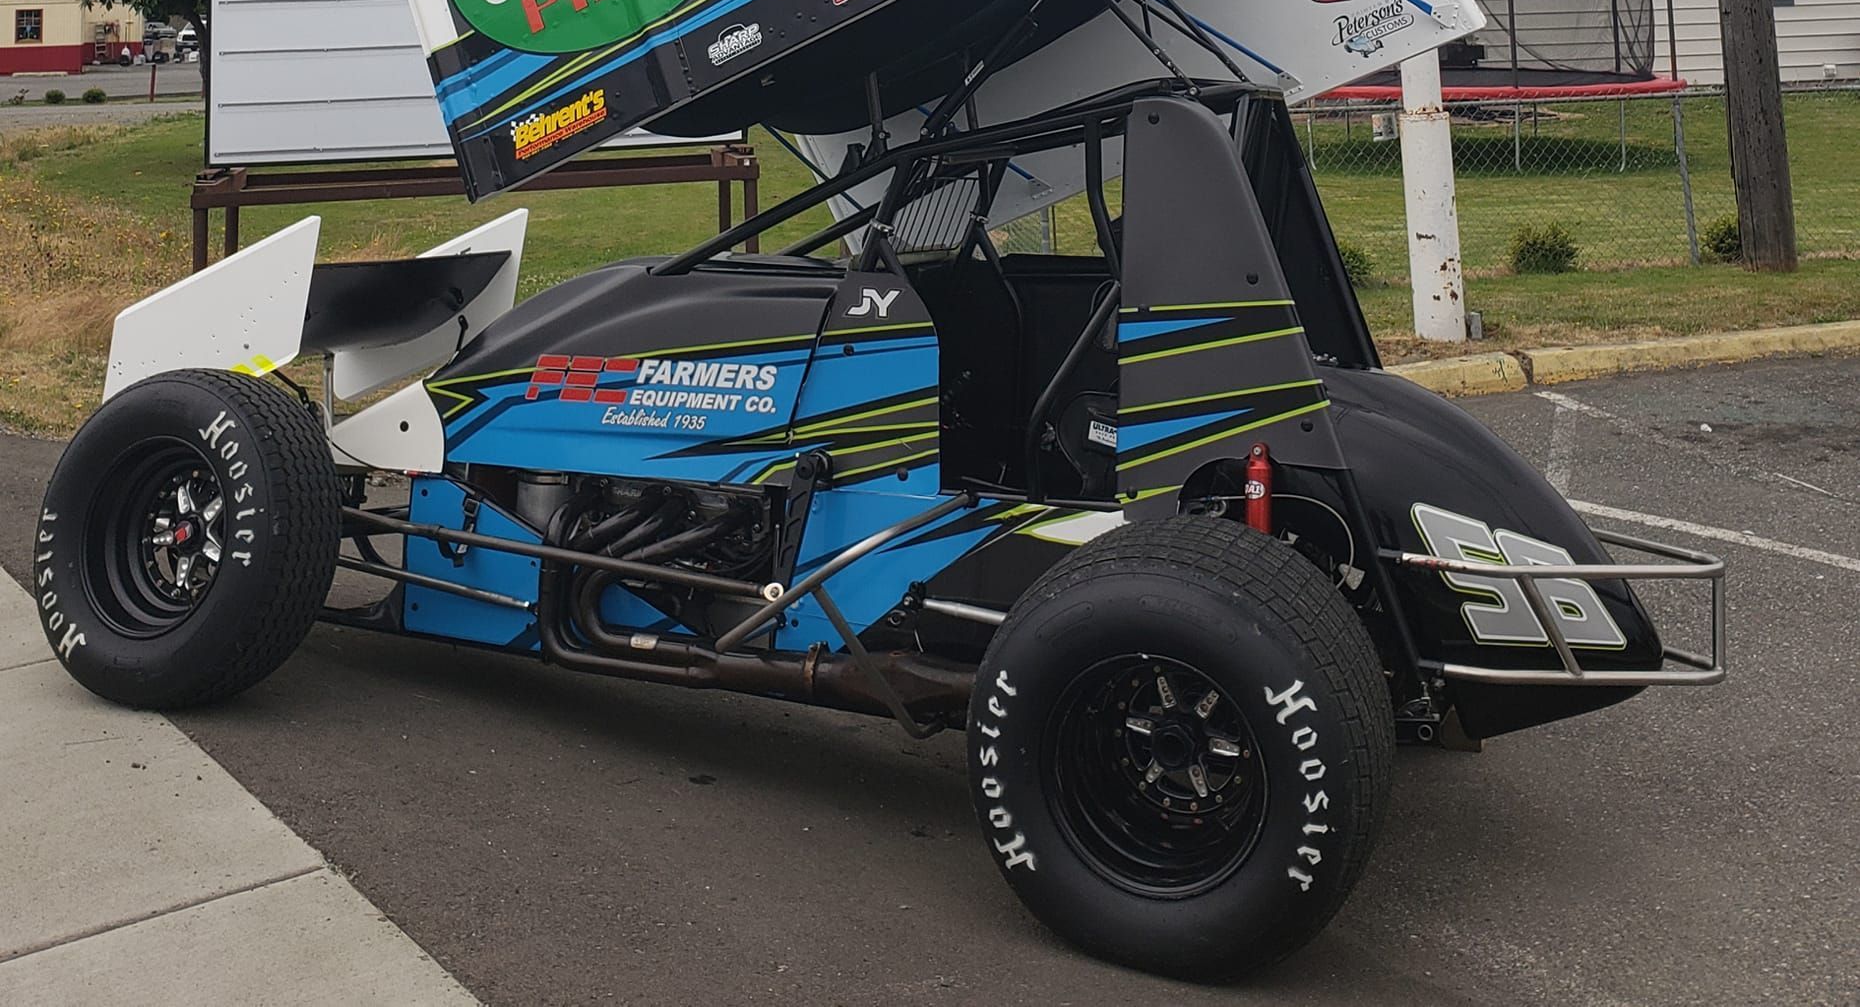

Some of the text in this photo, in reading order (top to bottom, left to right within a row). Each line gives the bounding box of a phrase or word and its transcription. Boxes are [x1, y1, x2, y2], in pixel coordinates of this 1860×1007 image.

[708, 23, 760, 57] SHARP
[1332, 0, 1404, 44] Peterson's
[1366, 16, 1408, 39] CUSTOMS
[516, 89, 605, 149] Behrent's
[844, 287, 902, 319] JY
[636, 360, 778, 391] FARMERS
[601, 406, 706, 430] Established 1935
[629, 390, 777, 414] EQUIPMENT CO.
[199, 410, 265, 567] Hoosier
[37, 507, 87, 662] Hoosier
[1410, 502, 1627, 650] 56
[976, 670, 1036, 871] Hoosier
[1263, 679, 1336, 892] Hoosier
